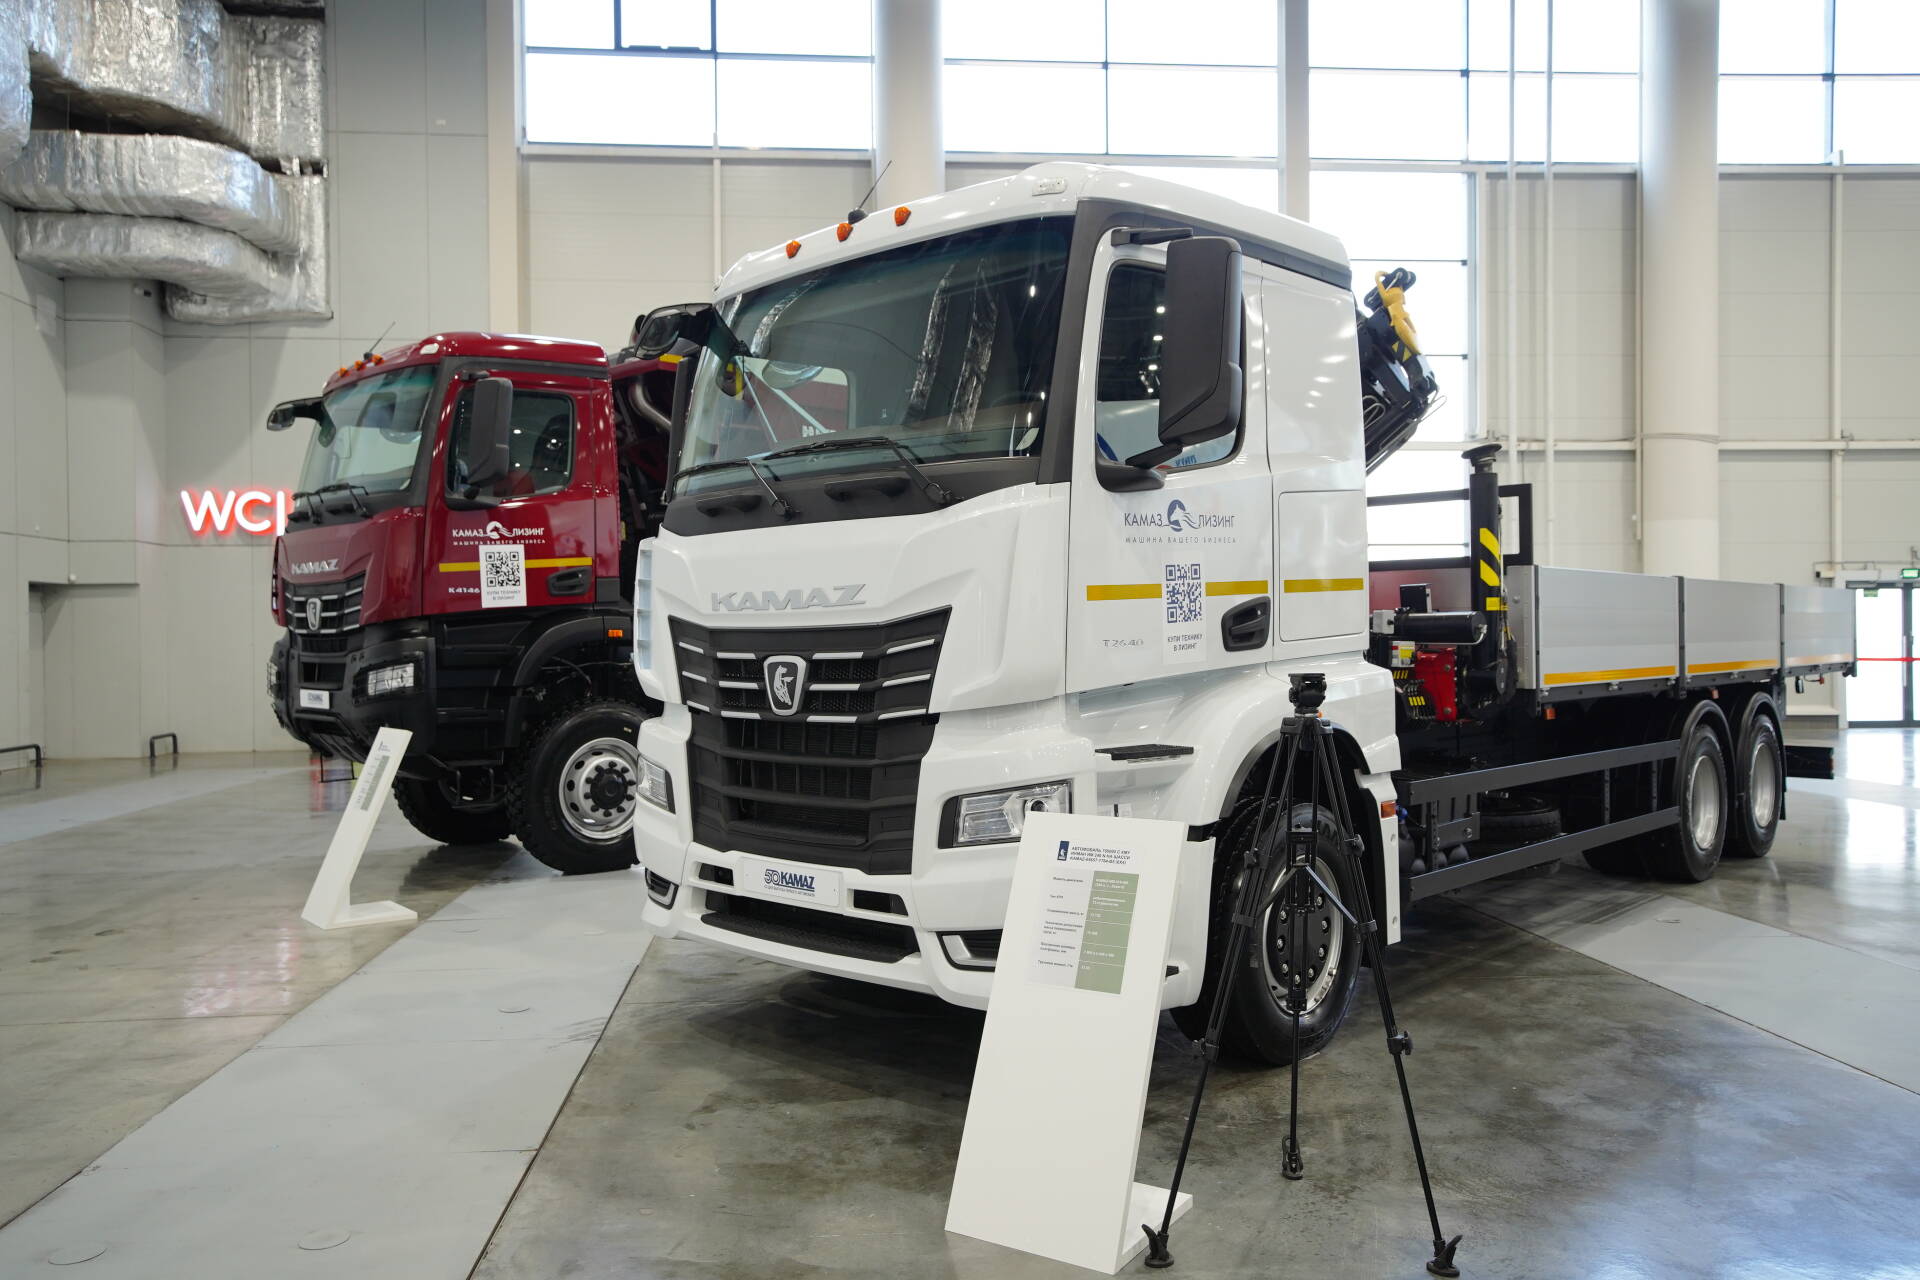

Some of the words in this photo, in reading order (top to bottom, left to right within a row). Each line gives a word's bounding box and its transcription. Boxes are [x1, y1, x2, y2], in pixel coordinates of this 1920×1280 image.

[1124, 513, 1163, 527] КАМАЗ
[1198, 514, 1235, 528] ЛИЗИНГ
[452, 528, 483, 537] КАМАЗ
[512, 528, 545, 537] ЛИЗИНГ
[1125, 536, 1163, 544] МАШИНА
[1167, 536, 1199, 544] ВАШЕГО
[291, 558, 340, 575] KAMAZ
[711, 583, 866, 612] KAMAZ
[780, 871, 815, 890] KAMAZ
